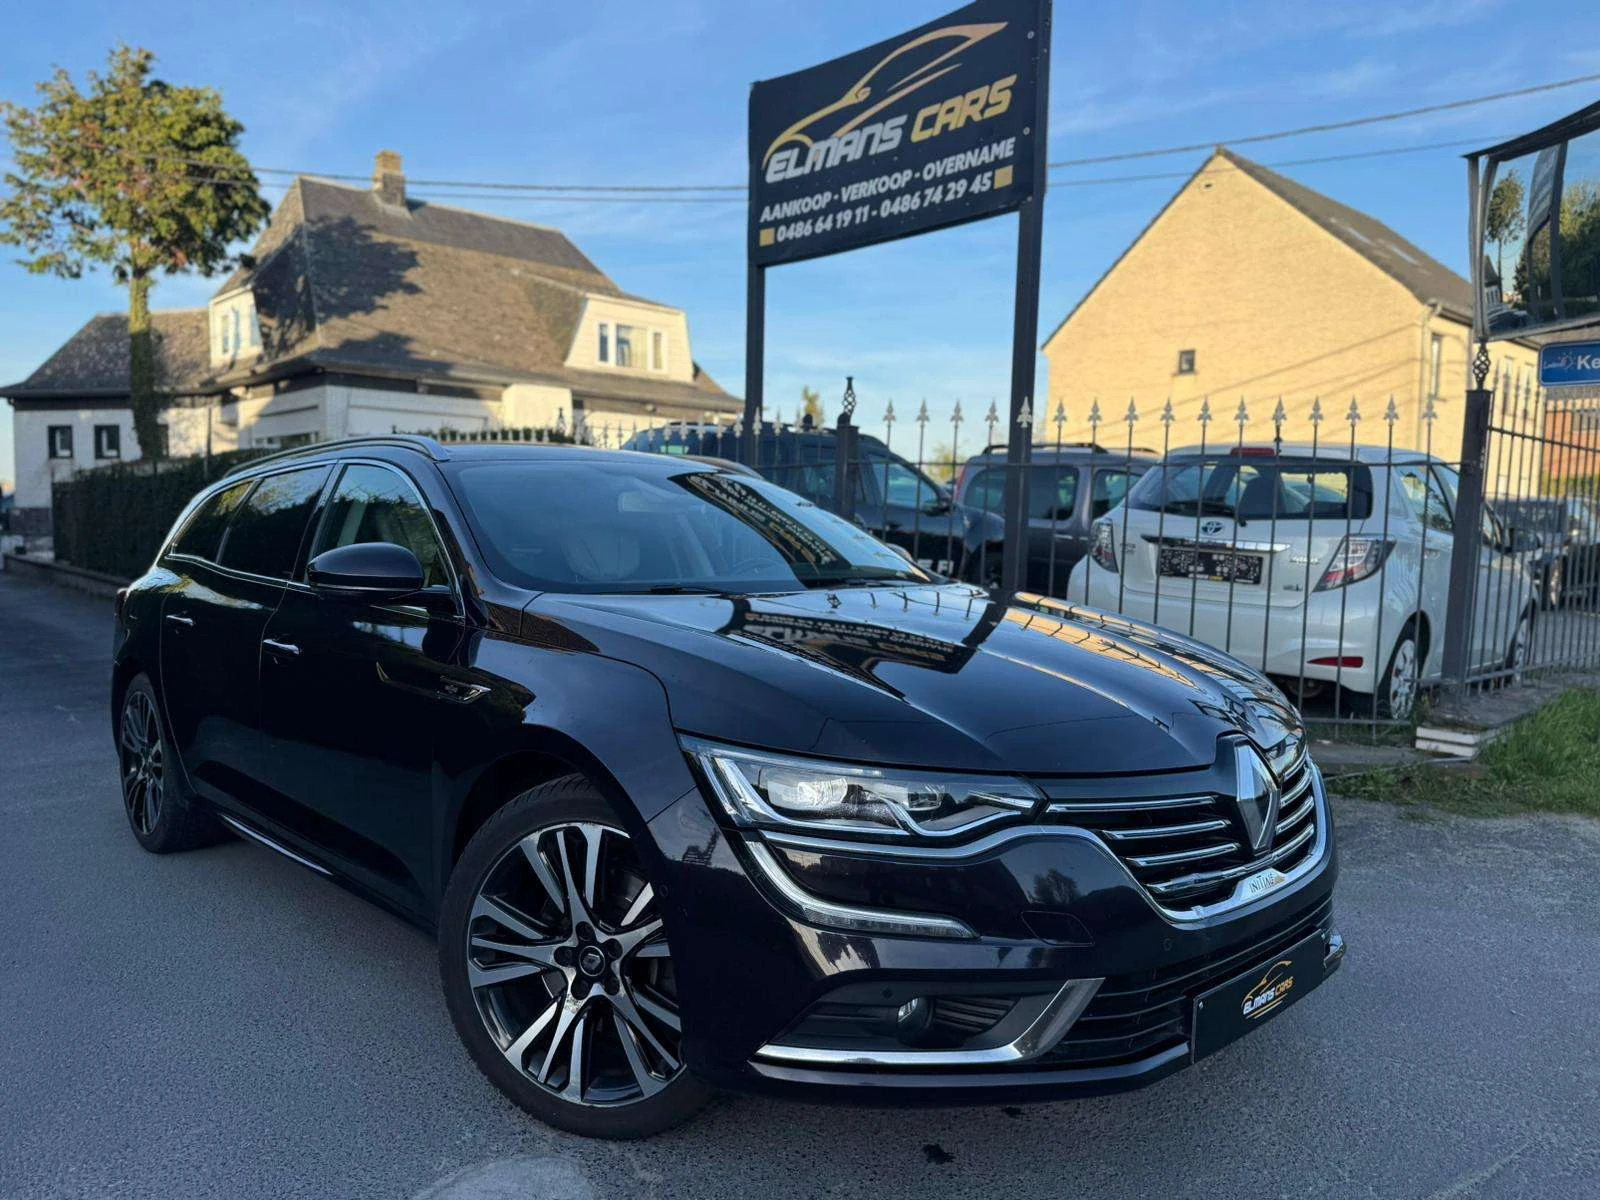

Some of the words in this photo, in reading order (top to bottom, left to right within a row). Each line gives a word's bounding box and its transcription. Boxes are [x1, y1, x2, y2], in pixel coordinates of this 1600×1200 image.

[765, 114, 907, 184] ELMANS
[910, 74, 1018, 143] CARS
[760, 191, 832, 223] AANKOOP
[841, 169, 913, 203] VERKOOP
[922, 137, 1016, 181] OVERNAME
[776, 219, 813, 242] 0486
[814, 213, 834, 234] 64
[835, 209, 853, 229] 19
[855, 204, 870, 225] 11
[880, 191, 921, 218] 0486
[923, 185, 943, 207] 74
[944, 179, 968, 202] 29
[969, 171, 993, 194] 45
[1577, 354, 1600, 370] Ke
